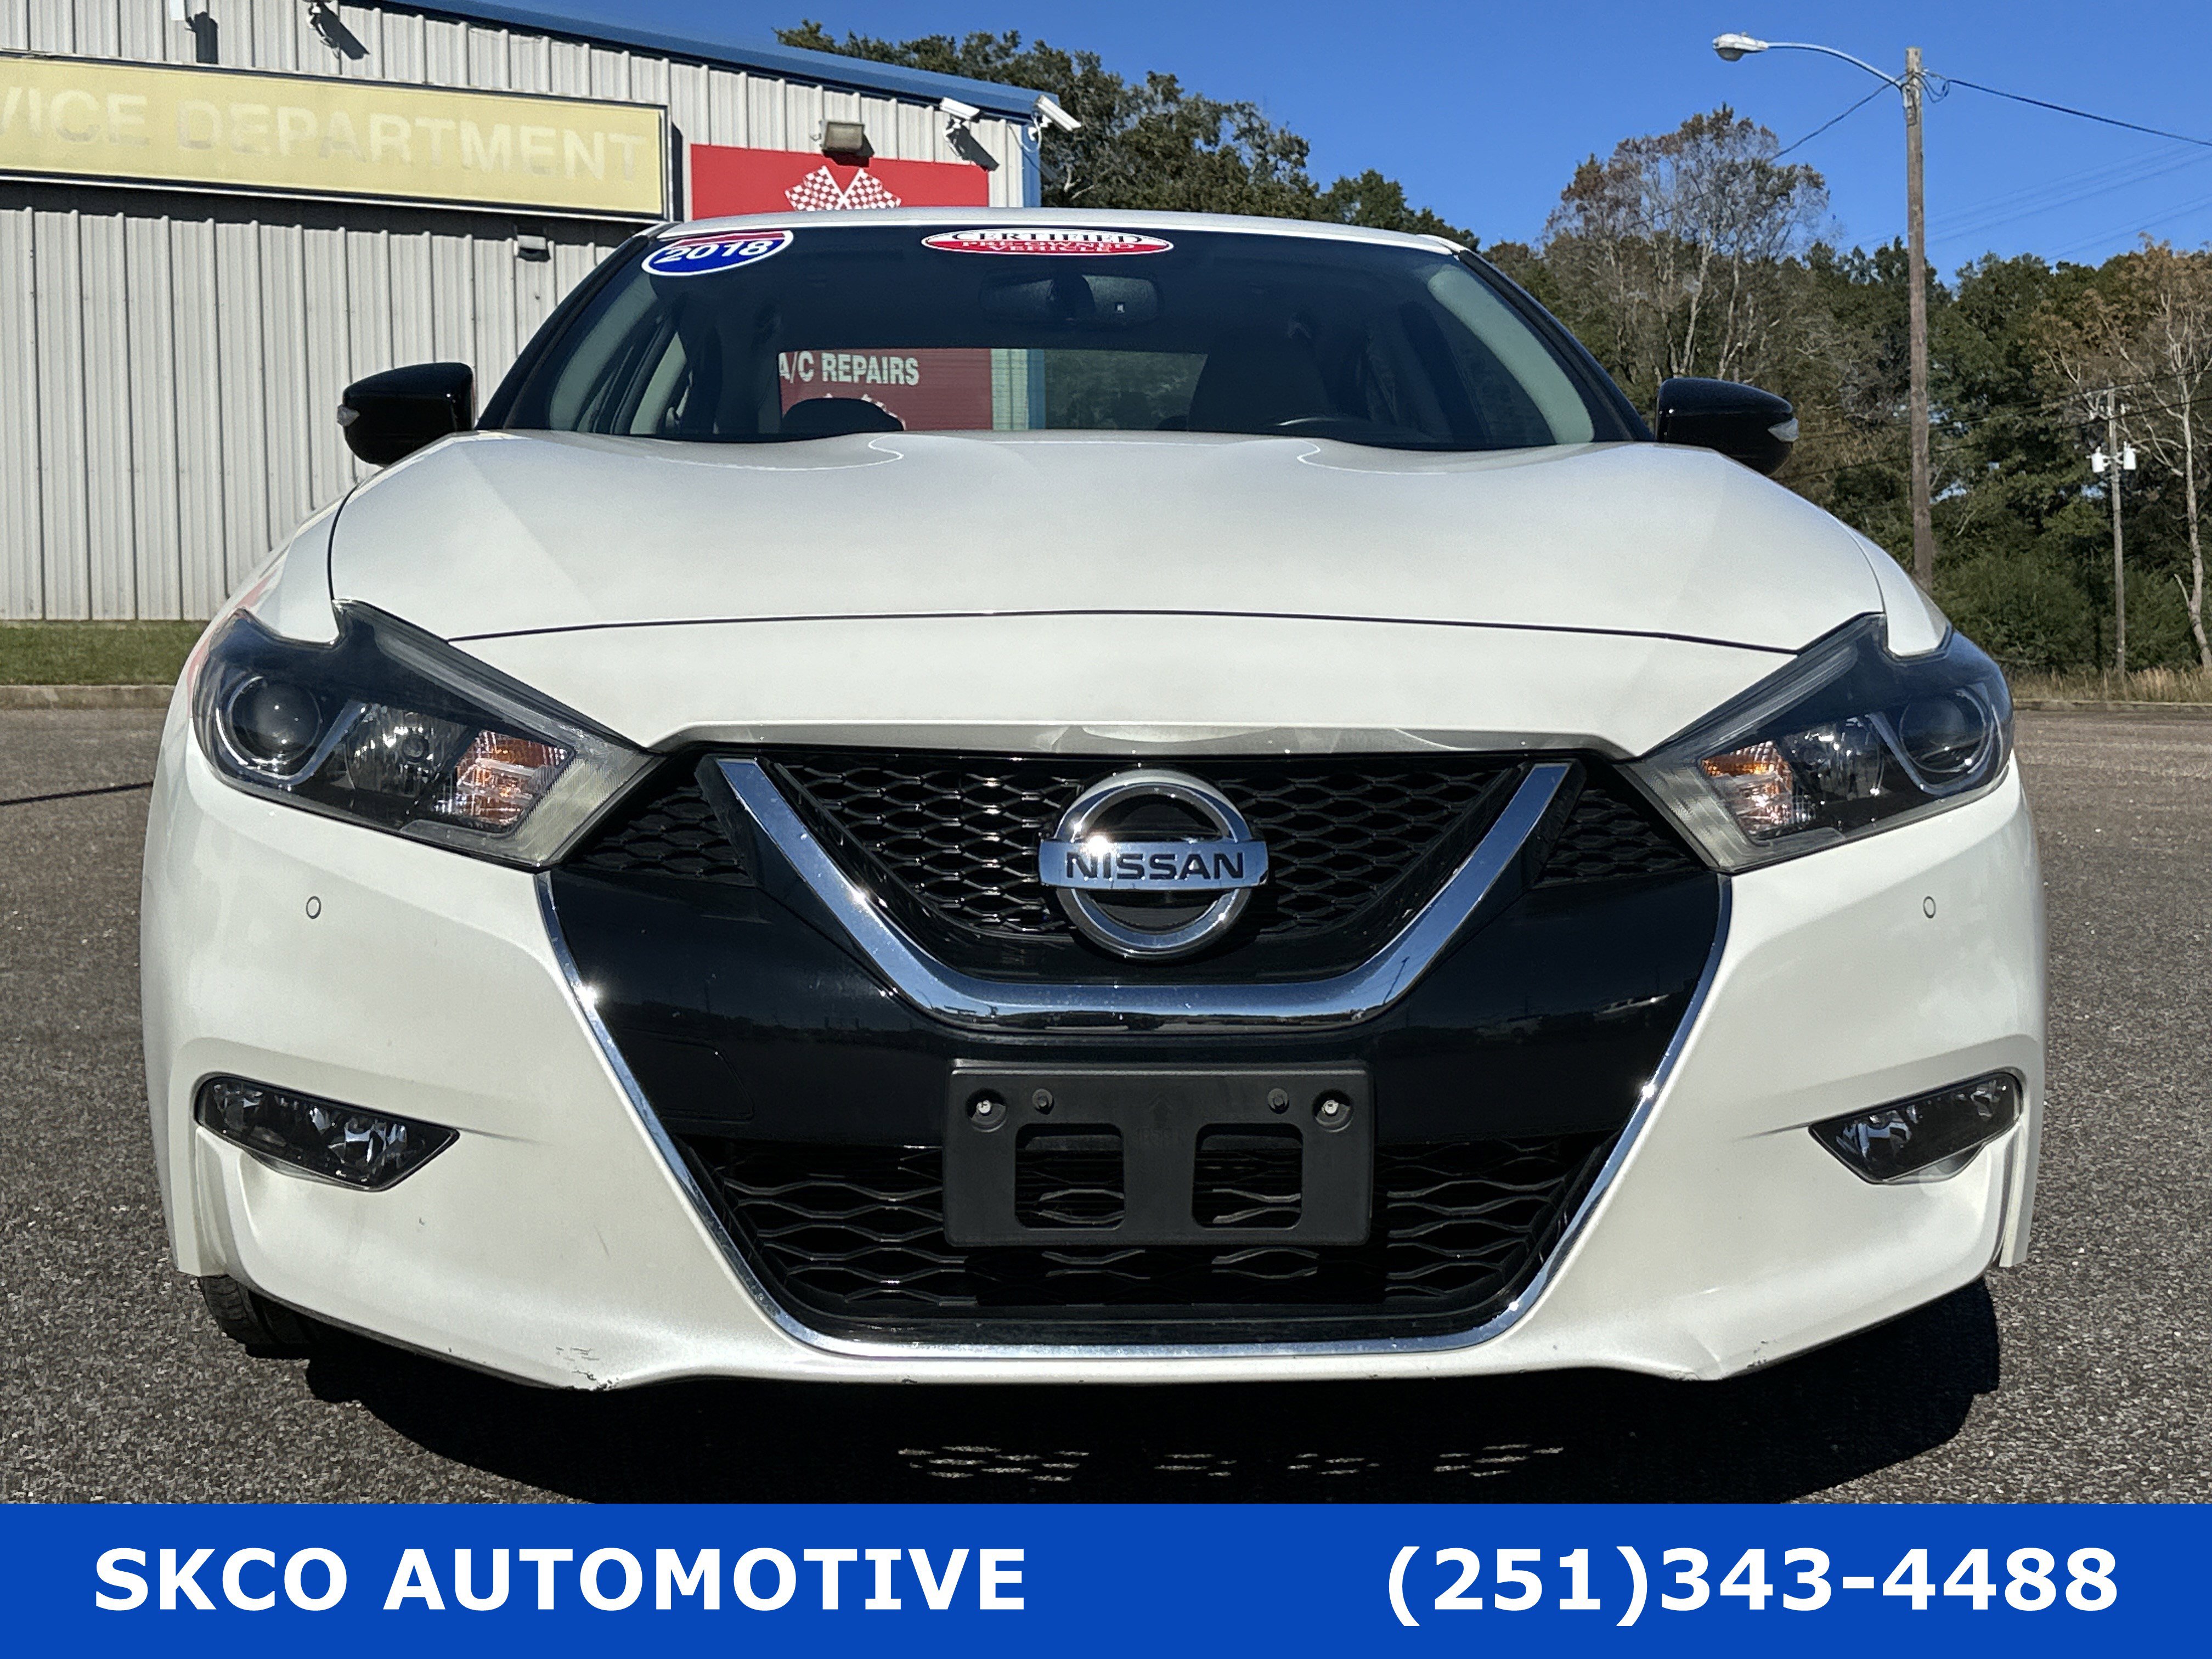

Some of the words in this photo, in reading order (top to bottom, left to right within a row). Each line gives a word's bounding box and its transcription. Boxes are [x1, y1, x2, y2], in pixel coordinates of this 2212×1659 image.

[177, 98, 646, 182] DEPARTMENT
[952, 232, 1142, 243] CERTIFIED
[653, 241, 774, 264] 2018
[779, 351, 815, 383] A/C
[822, 352, 920, 386] REPAIRS
[1065, 852, 1244, 881] NISSAN
